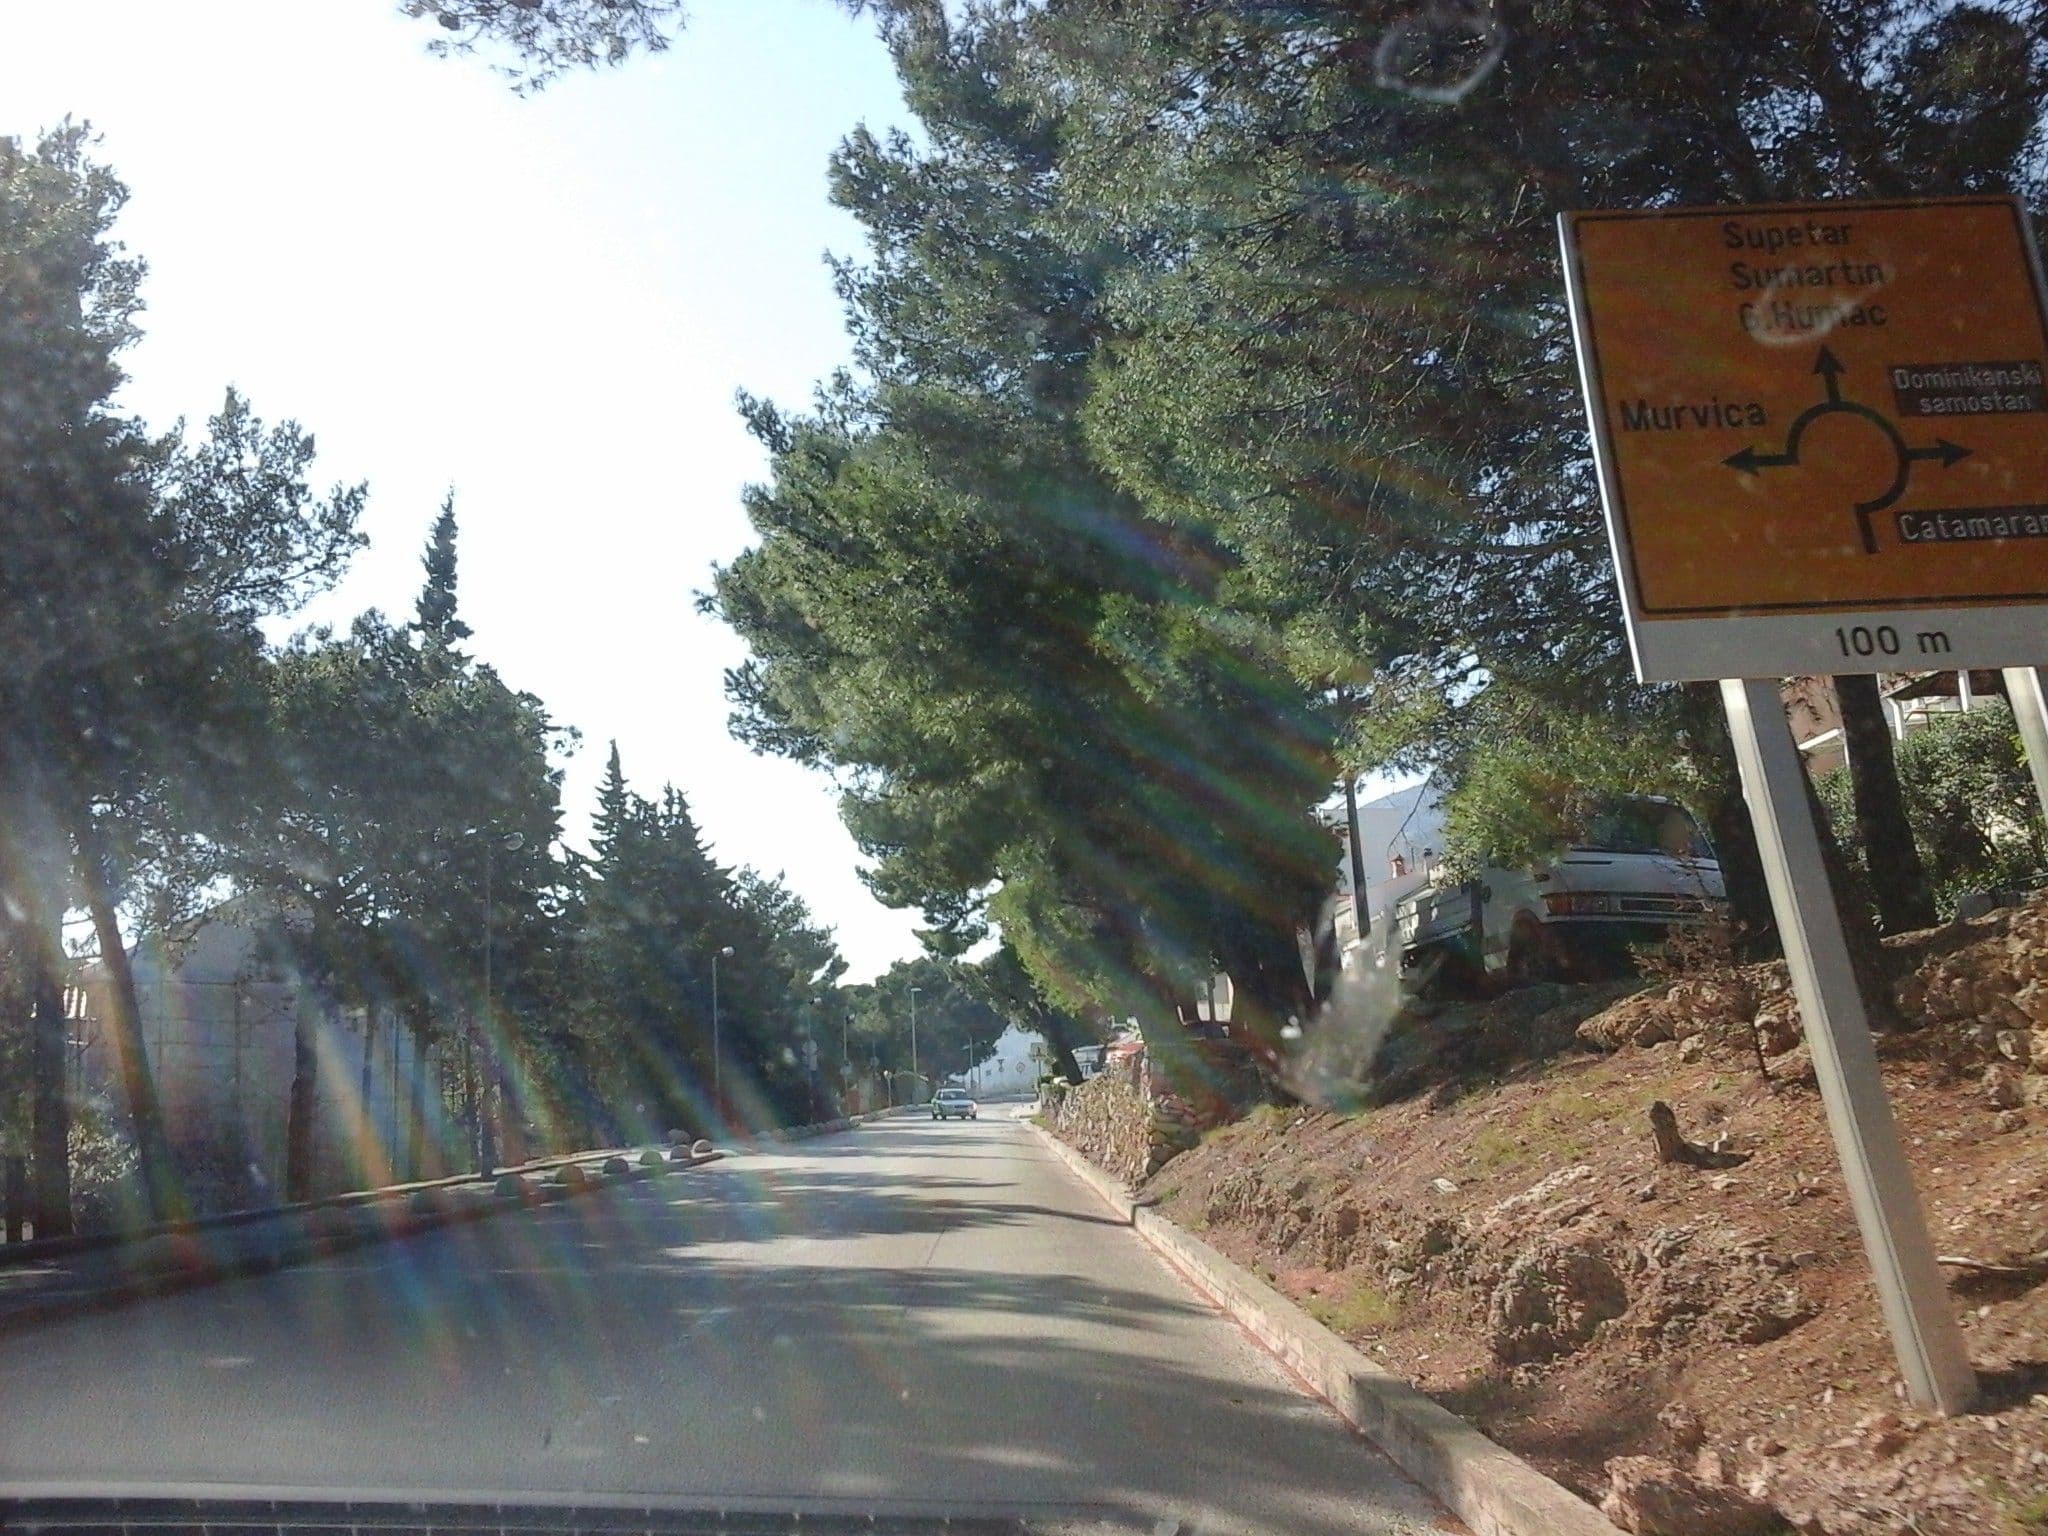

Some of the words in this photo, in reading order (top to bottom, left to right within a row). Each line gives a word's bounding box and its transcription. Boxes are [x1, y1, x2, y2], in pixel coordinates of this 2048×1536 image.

[1722, 220, 1850, 255] Supetar
[1730, 260, 1884, 290] Sumartin
[1893, 362, 2042, 390] Dominikanski
[1620, 396, 1767, 431] Murvica
[1919, 391, 2032, 413] samostan
[1835, 625, 1900, 657] 100
[1916, 631, 1952, 653] m
